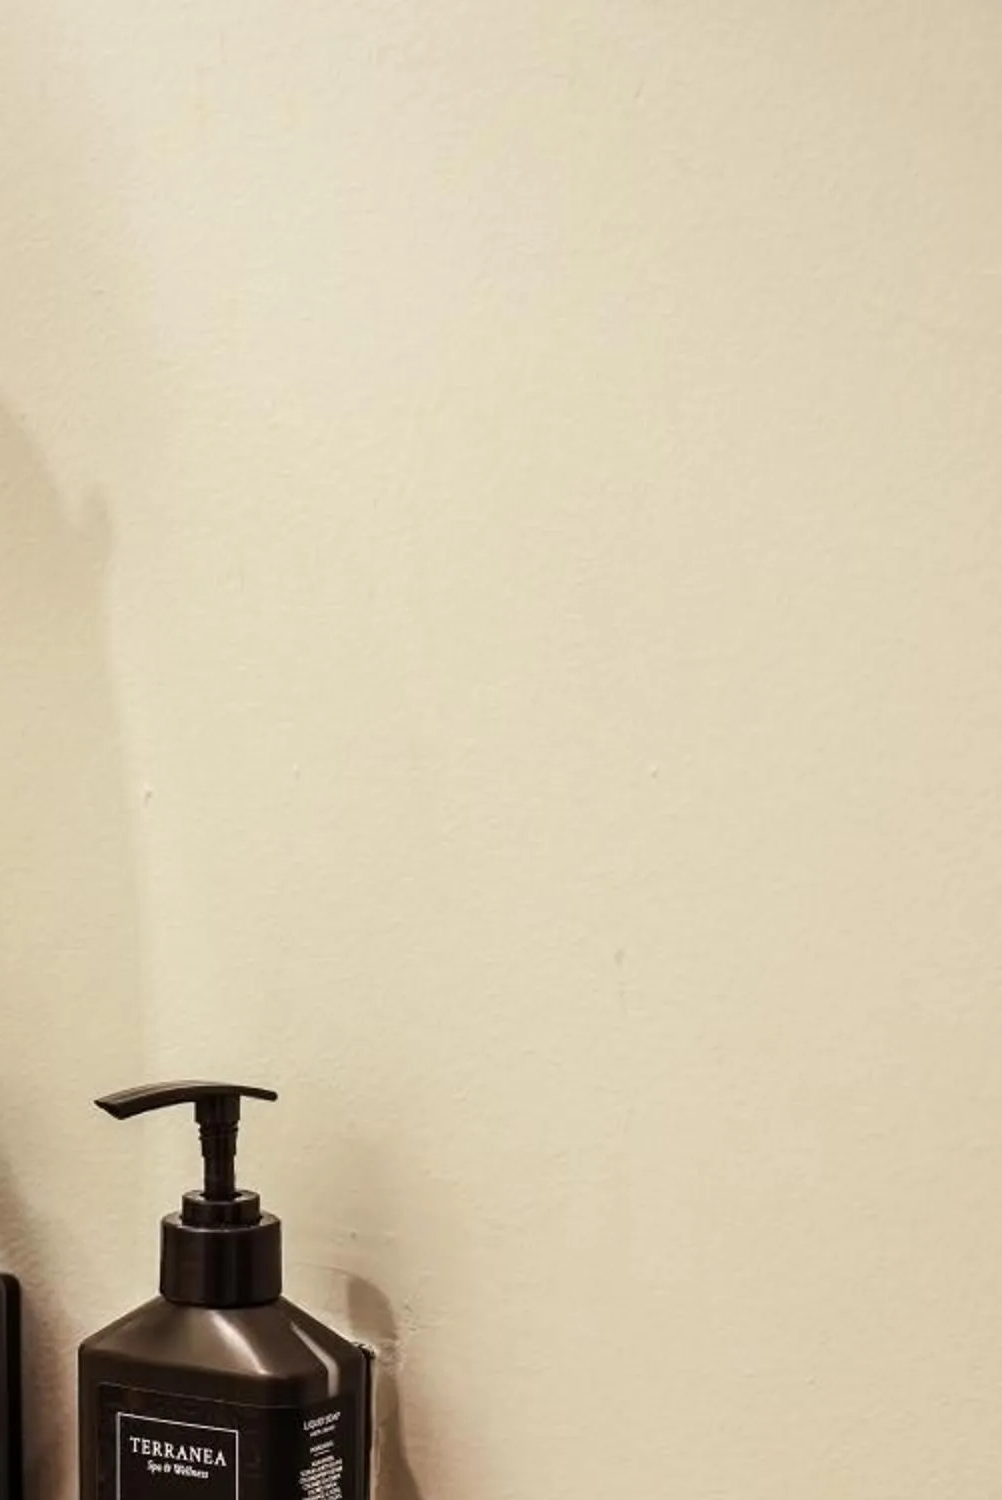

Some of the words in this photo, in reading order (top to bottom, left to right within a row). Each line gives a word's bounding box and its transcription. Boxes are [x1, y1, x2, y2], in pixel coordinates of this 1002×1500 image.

[129, 1436, 227, 1467] TERRANEA
[147, 1459, 162, 1475] Spa
[173, 1463, 209, 1479] Wellness
